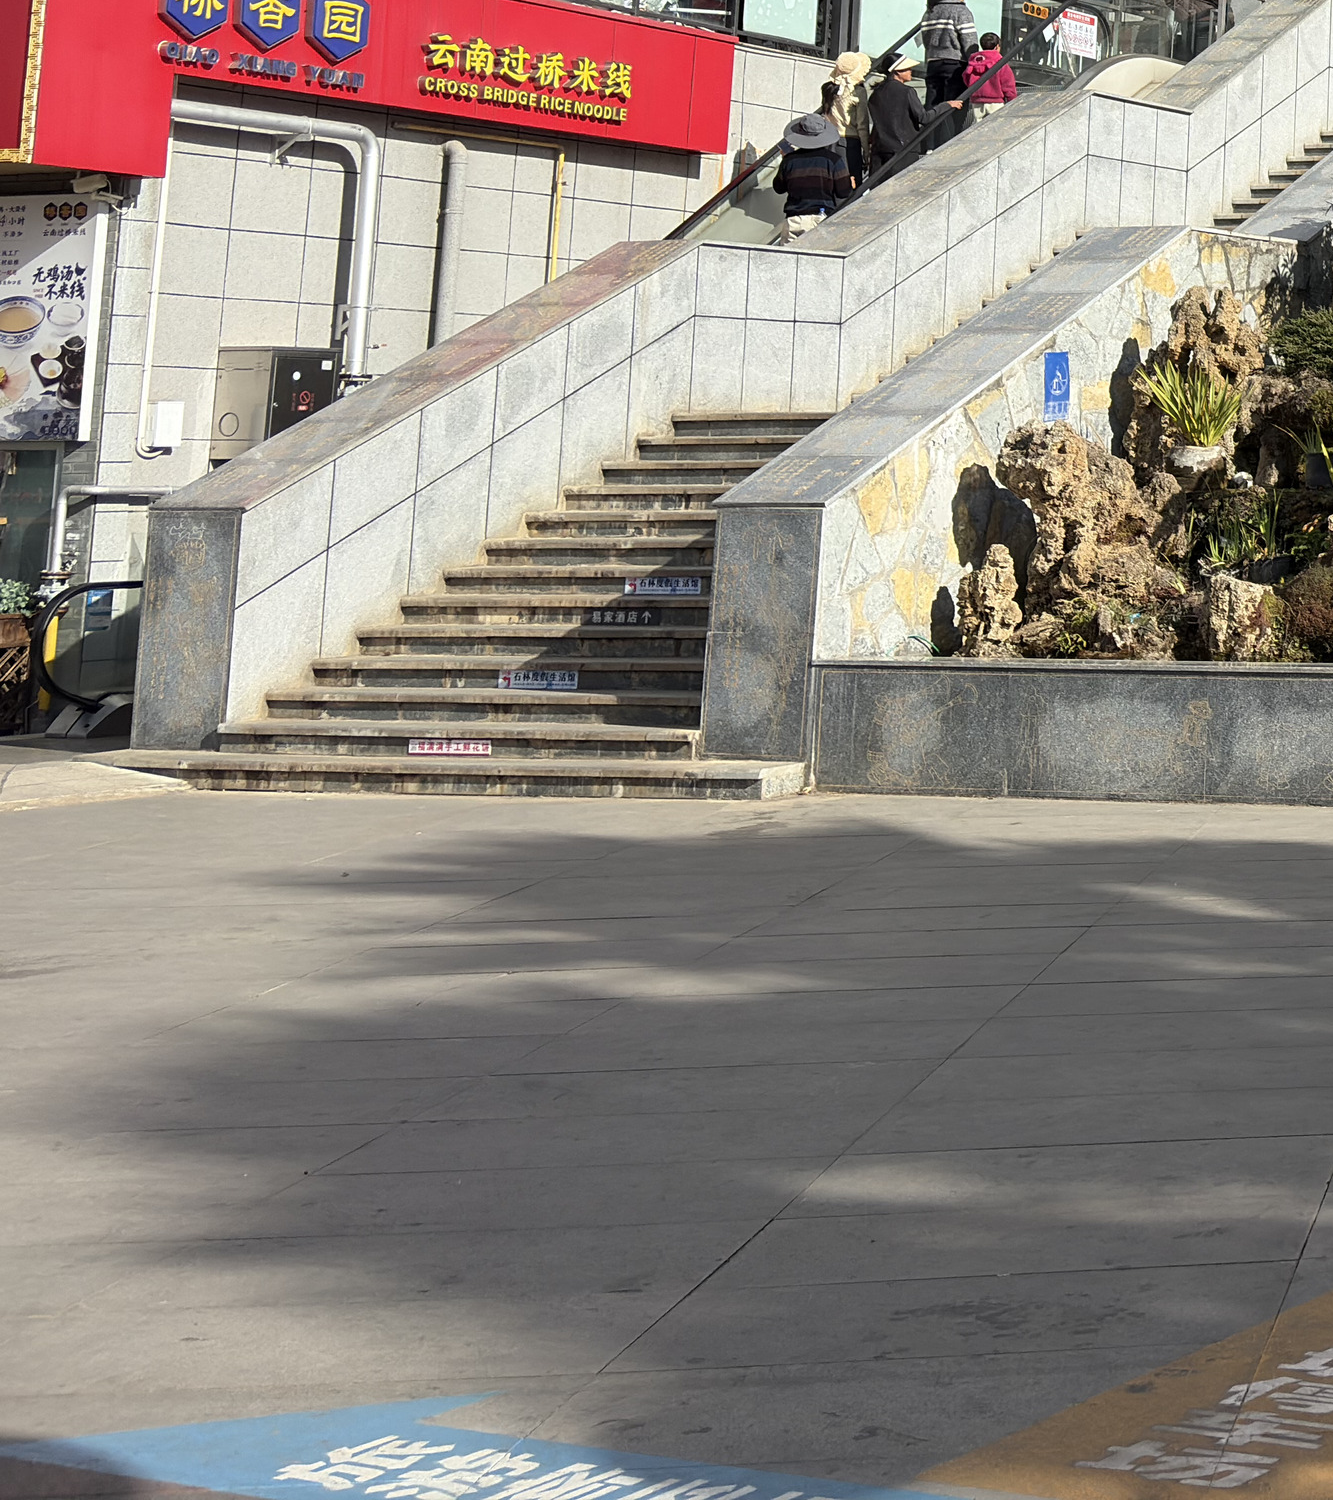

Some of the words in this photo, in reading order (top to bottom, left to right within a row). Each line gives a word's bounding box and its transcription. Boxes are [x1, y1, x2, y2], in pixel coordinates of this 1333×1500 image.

[160, 41, 220, 66] QIAO
[305, 65, 365, 89] YUAN
[424, 33, 633, 99] 云南过桥米线
[424, 76, 479, 99] CROSS
[483, 87, 538, 108] BRIDGE
[540, 95, 573, 114] RICE
[574, 102, 628, 122] NOODLE
[592, 610, 638, 624] 易家酒店
[513, 671, 577, 682] 石林度假生活馆
